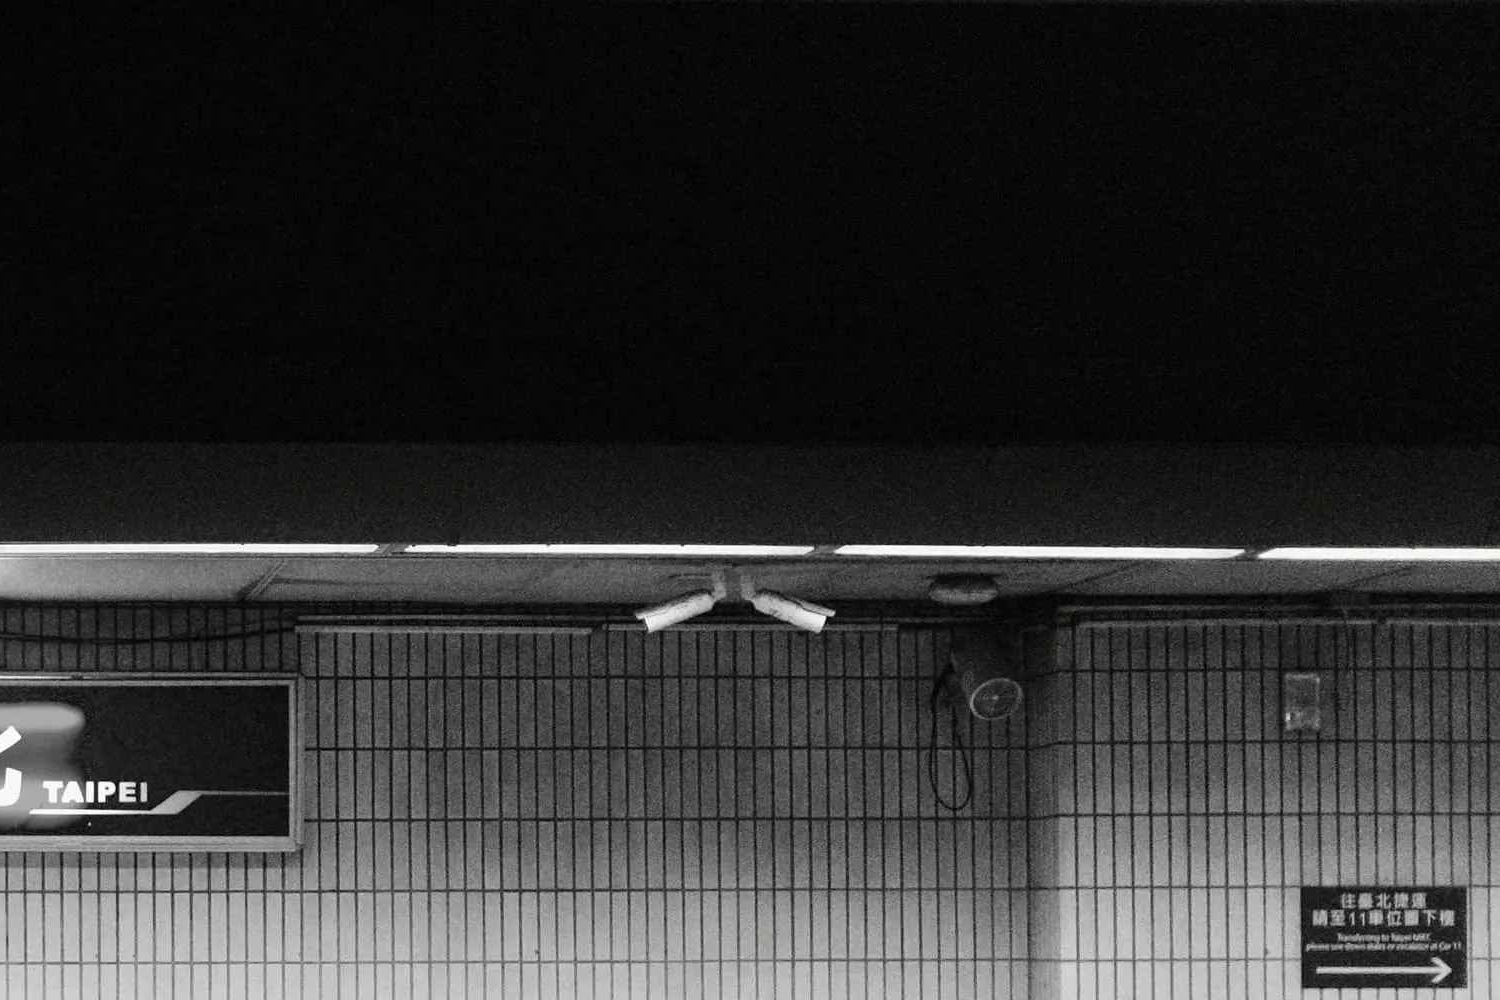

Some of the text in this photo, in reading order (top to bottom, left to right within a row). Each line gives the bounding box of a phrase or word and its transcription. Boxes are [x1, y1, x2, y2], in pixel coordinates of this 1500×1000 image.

[42, 780, 148, 804] TAIPEI
[1341, 892, 1427, 910] 往臺北捷運
